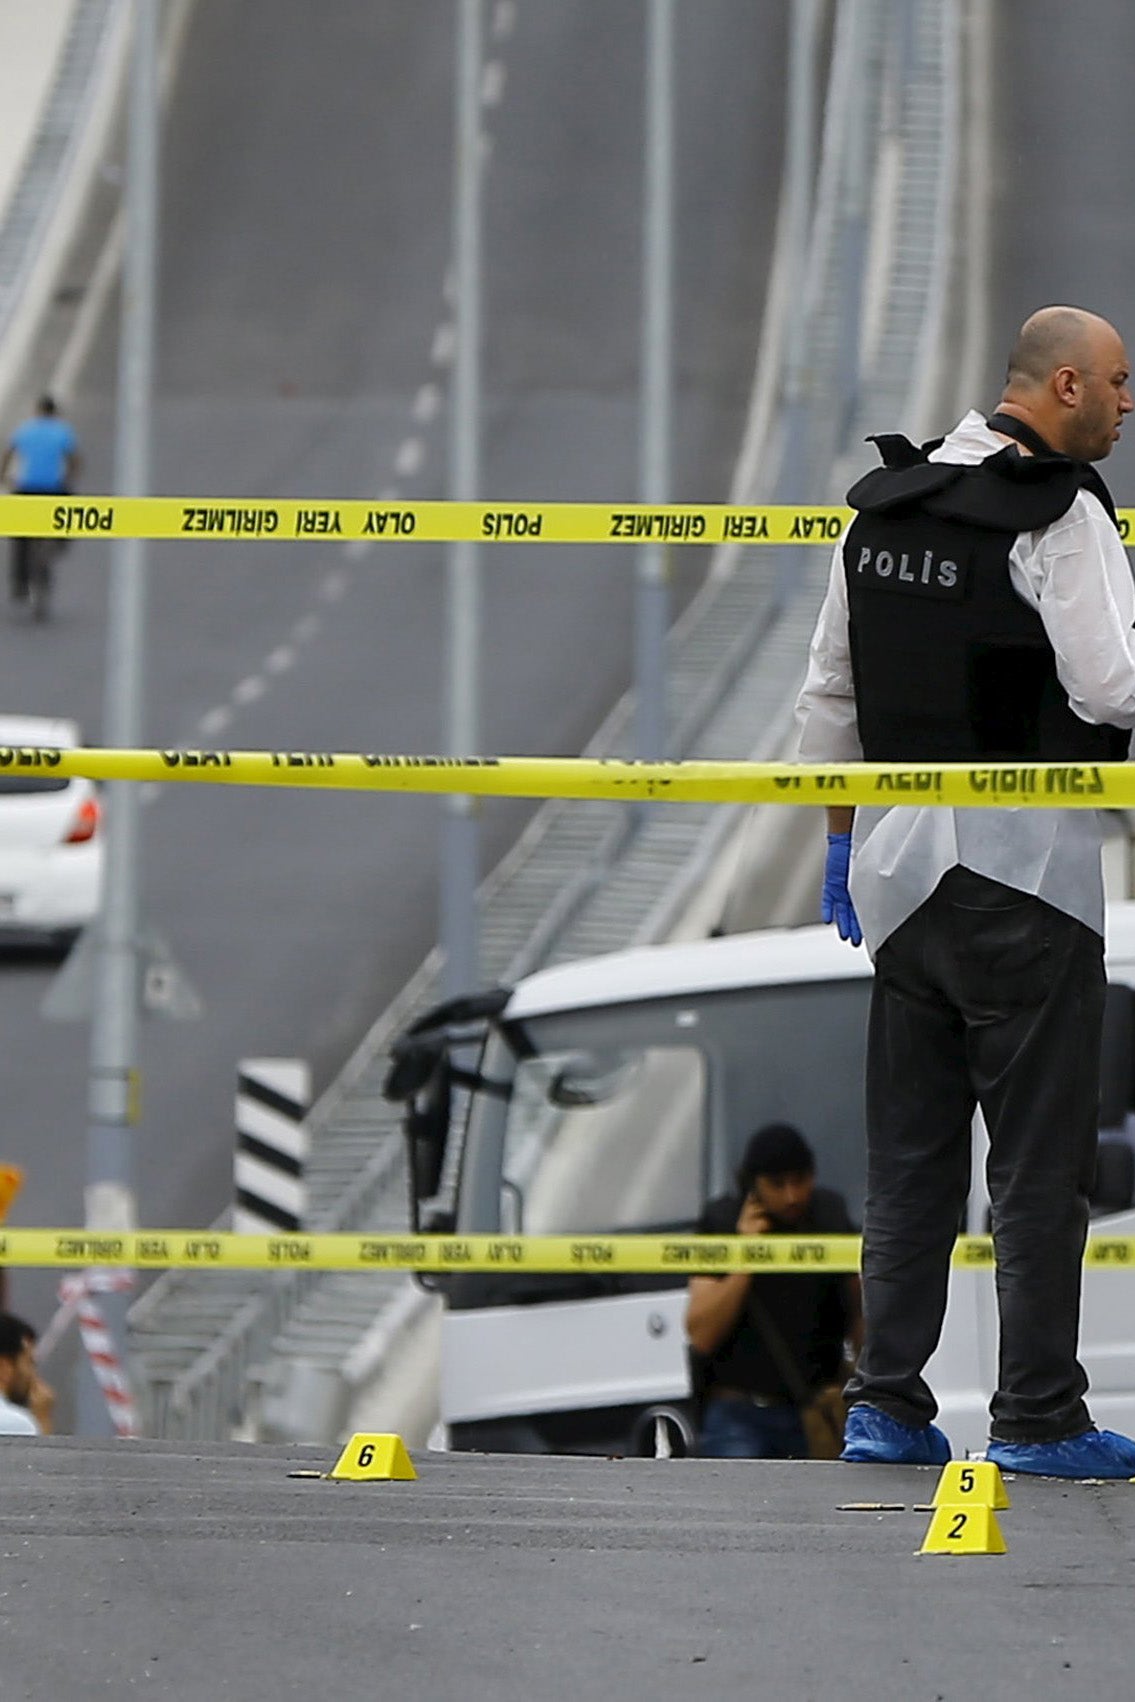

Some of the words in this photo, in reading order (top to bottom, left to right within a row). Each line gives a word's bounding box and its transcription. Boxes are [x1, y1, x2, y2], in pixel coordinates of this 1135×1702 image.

[53, 507, 114, 535] POLİS
[363, 512, 416, 535] OLAY
[483, 513, 542, 540] POLİS
[790, 517, 842, 539] OLAY
[857, 547, 958, 588] POLİS
[358, 1444, 376, 1468] 6
[960, 1469, 975, 1493] 5
[947, 1513, 968, 1539] 2
